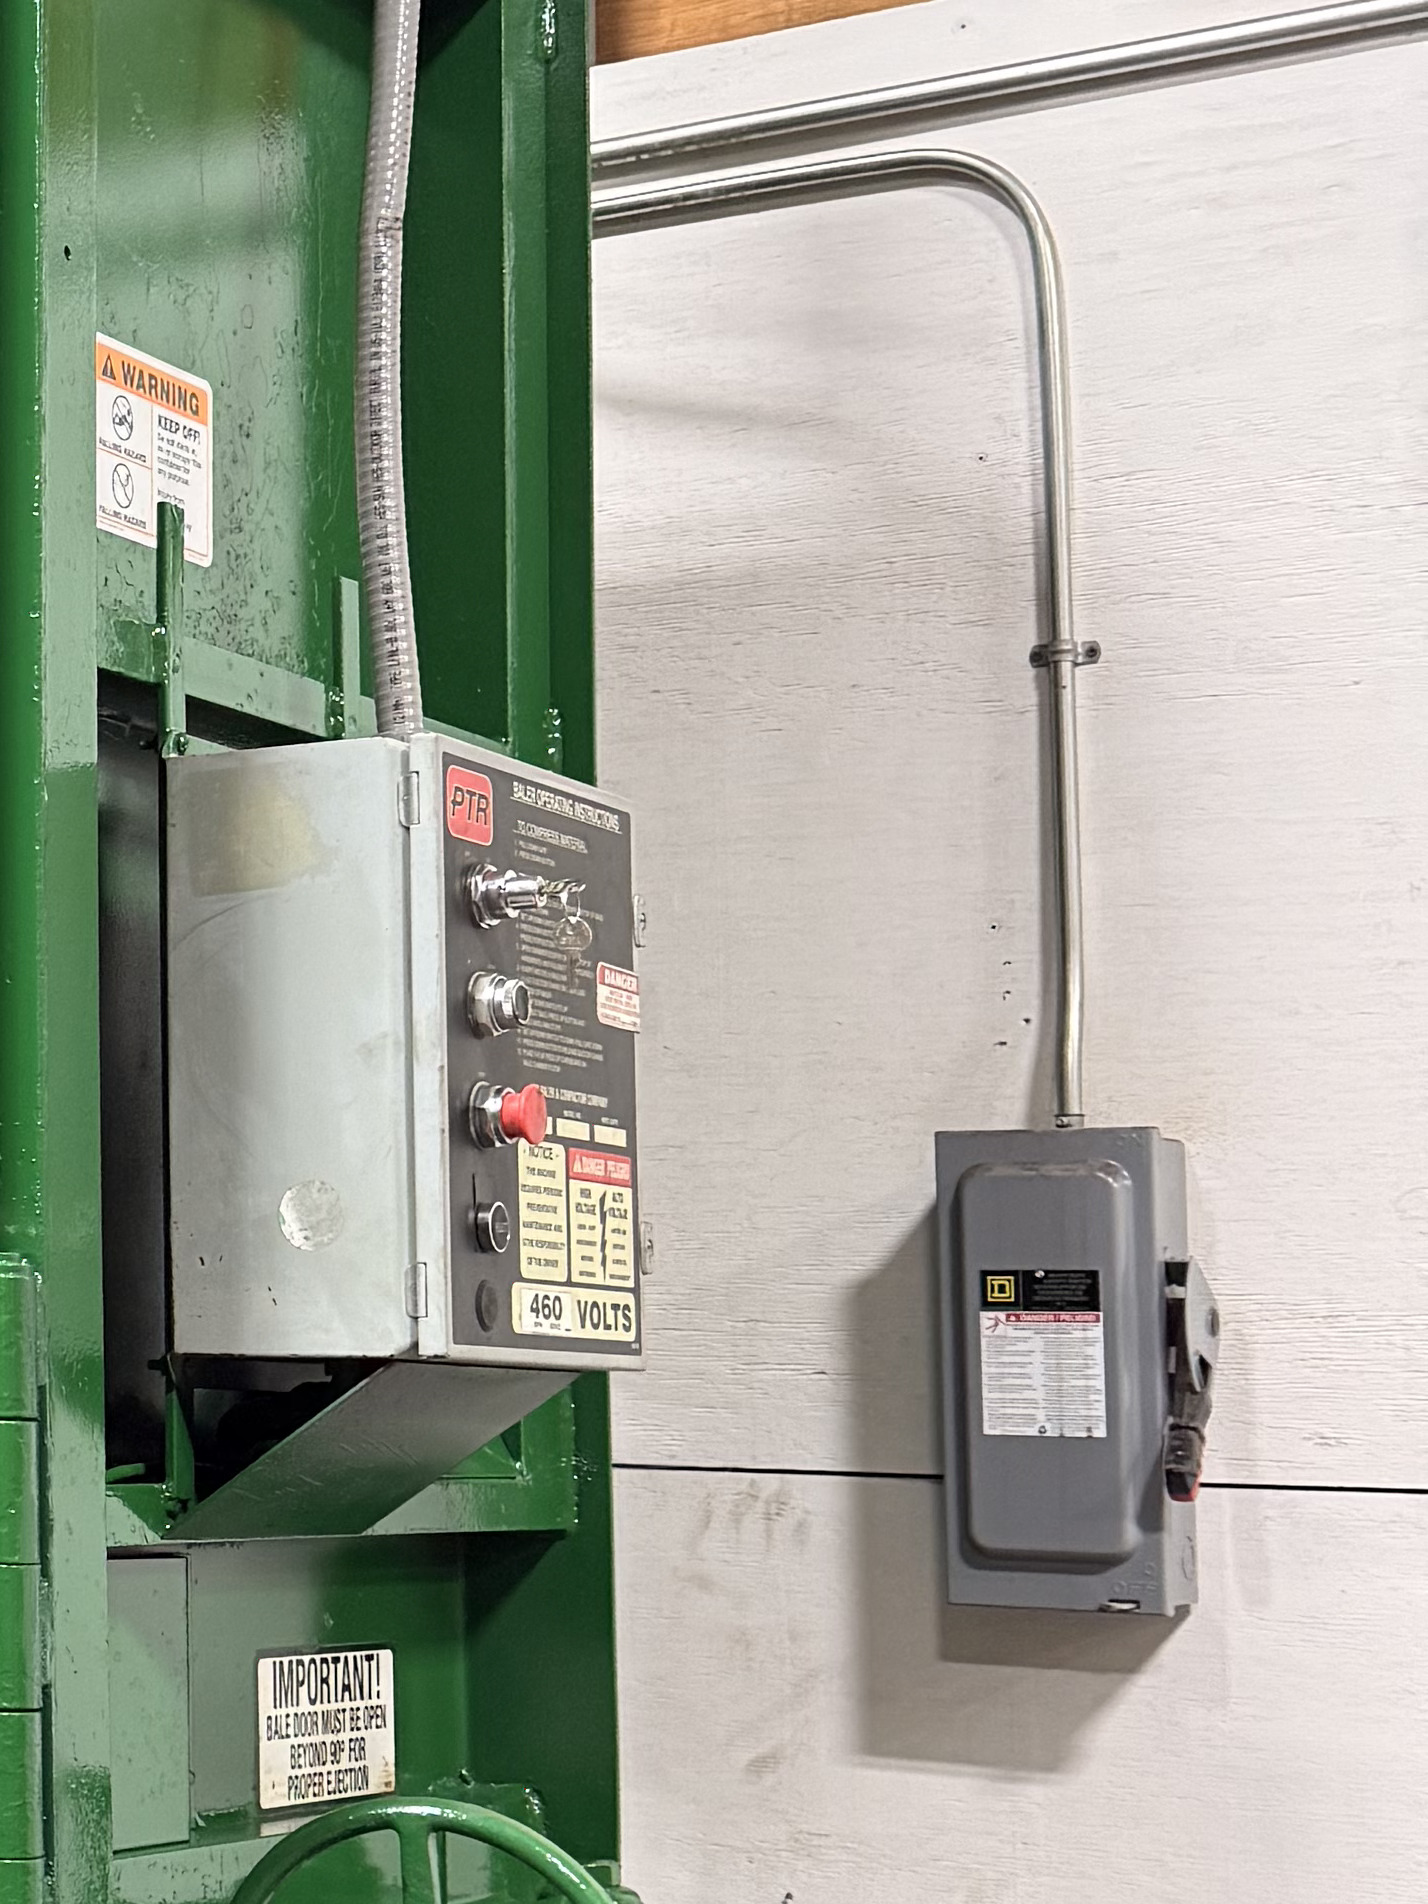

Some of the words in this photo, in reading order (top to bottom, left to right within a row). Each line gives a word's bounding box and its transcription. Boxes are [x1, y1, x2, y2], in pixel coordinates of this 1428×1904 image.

[121, 359, 200, 418] WARNING
[450, 786, 490, 826] PTR
[603, 968, 639, 994] DANGER
[530, 1292, 563, 1322] 460
[576, 1299, 632, 1333] VOLTS
[271, 1652, 382, 1710] IMPORTANT!
[265, 1712, 292, 1742] BALE
[292, 1710, 320, 1739] DOOR
[320, 1707, 348, 1736] MUST
[349, 1706, 363, 1733] BE
[362, 1703, 388, 1731] OPEN
[289, 1740, 329, 1771] BEYOND
[348, 1736, 366, 1764] FOR
[287, 1770, 325, 1802] PROPER
[325, 1764, 370, 1796] EJECTION
